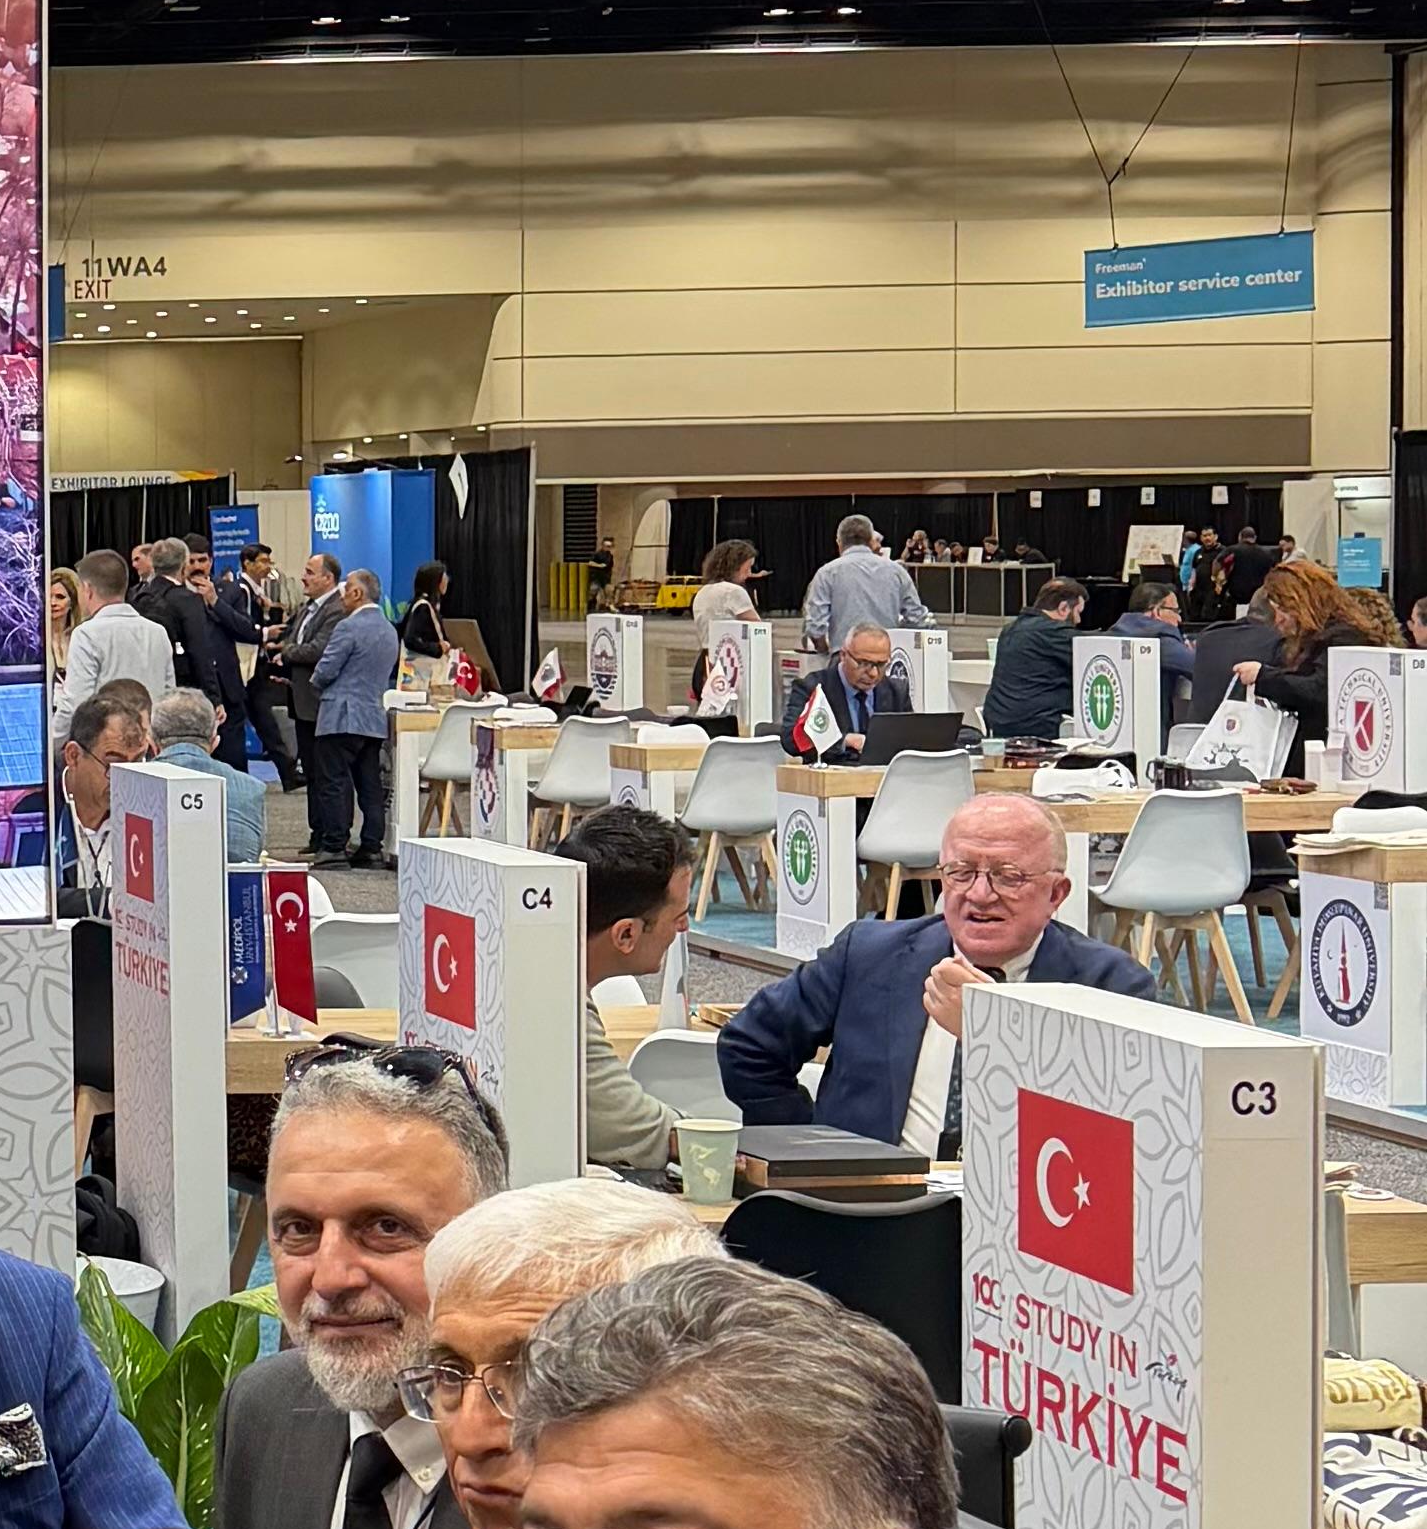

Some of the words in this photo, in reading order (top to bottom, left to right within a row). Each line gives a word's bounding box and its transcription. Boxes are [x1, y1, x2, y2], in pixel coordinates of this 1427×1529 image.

[82, 256, 167, 278] 11WA4
[74, 279, 112, 299] EXIT
[1095, 279, 1174, 299] Exhibitor
[1178, 272, 1240, 292] service
[1245, 268, 1303, 287] center
[51, 476, 118, 490] EXHIBITOR
[1139, 645, 1152, 655] D9
[180, 791, 204, 812] C5
[521, 887, 554, 911] C4
[115, 936, 170, 996] TÜRKİYE
[1230, 1080, 1277, 1116] C3
[1015, 1292, 1102, 1361] STUDY
[1109, 1331, 1137, 1378] IN
[972, 1335, 1188, 1505] TÜRKİYE
